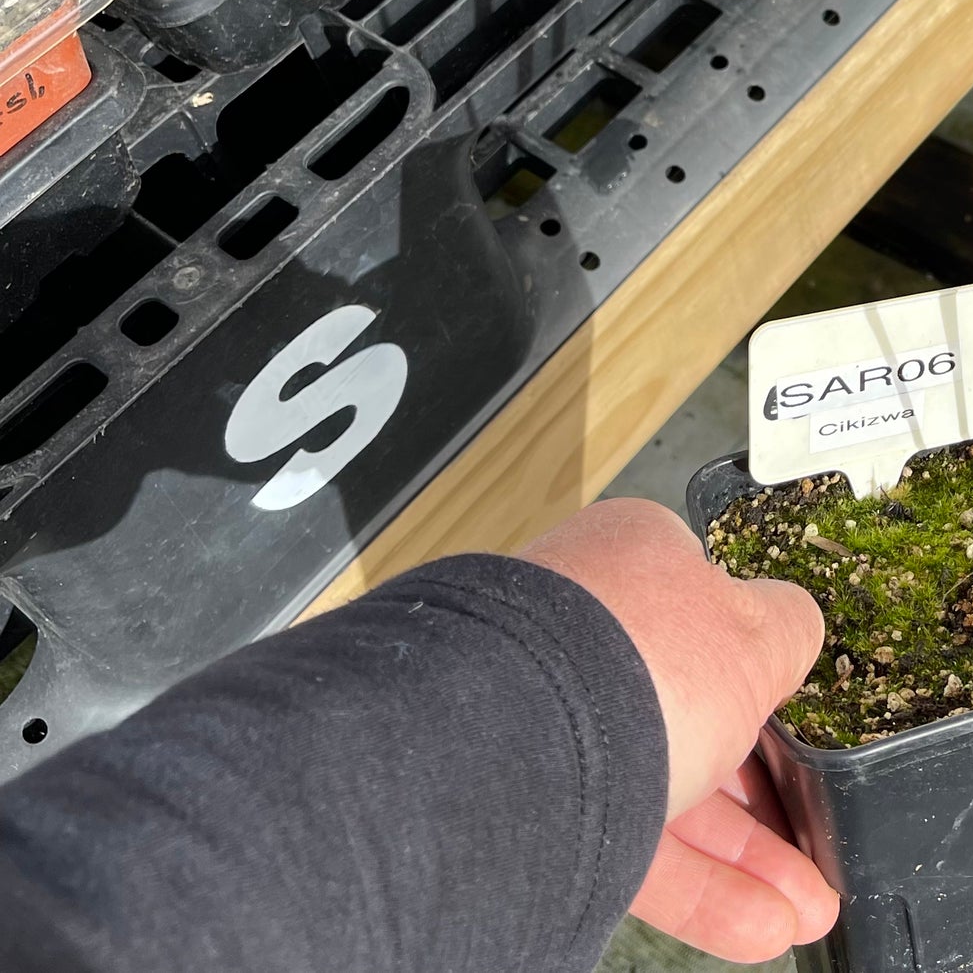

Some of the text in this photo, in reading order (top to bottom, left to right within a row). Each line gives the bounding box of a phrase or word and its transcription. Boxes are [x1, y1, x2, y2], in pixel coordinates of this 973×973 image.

[224, 304, 409, 511] S
[779, 351, 957, 408] SAR06
[817, 407, 916, 437] Cikizwa
